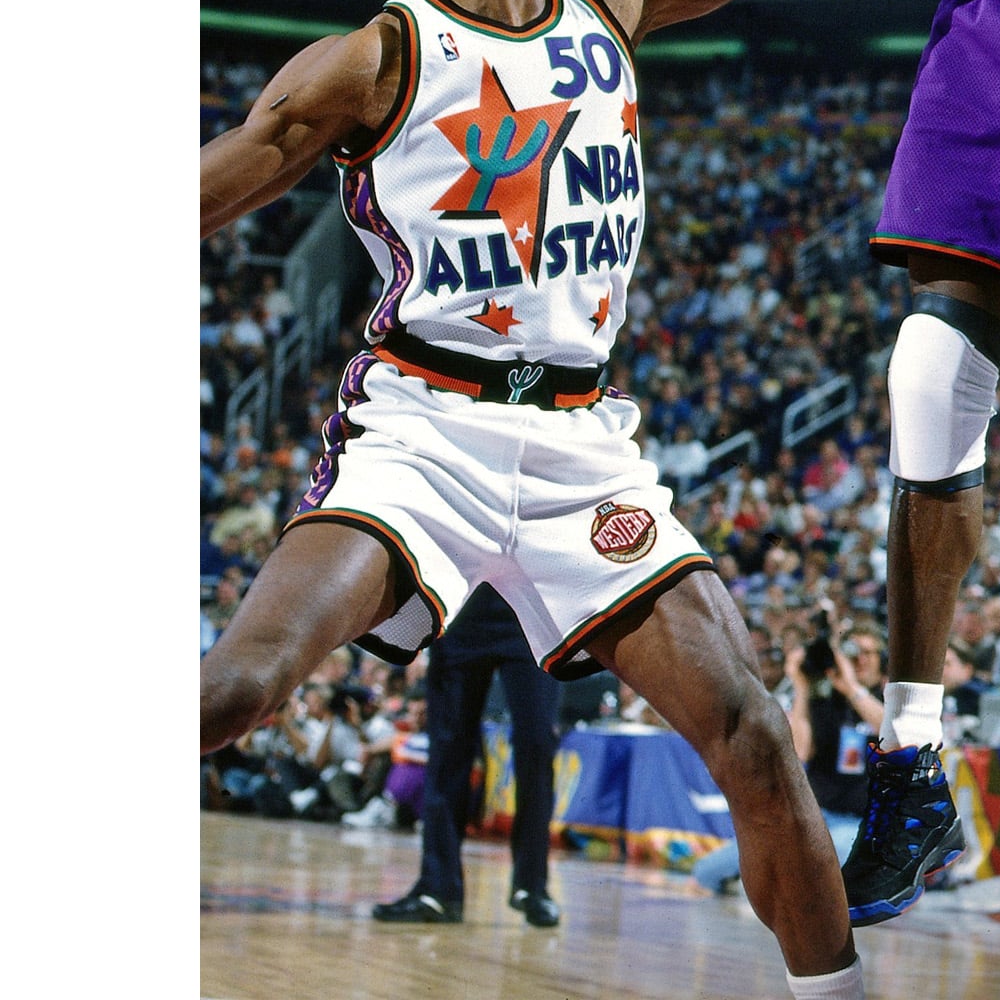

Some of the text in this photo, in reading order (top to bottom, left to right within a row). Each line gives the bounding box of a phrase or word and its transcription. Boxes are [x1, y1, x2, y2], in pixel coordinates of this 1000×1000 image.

[544, 32, 622, 100] 50
[562, 137, 641, 207] NBA
[424, 212, 639, 297] ALL STARS
[593, 511, 650, 549] WESTERN
